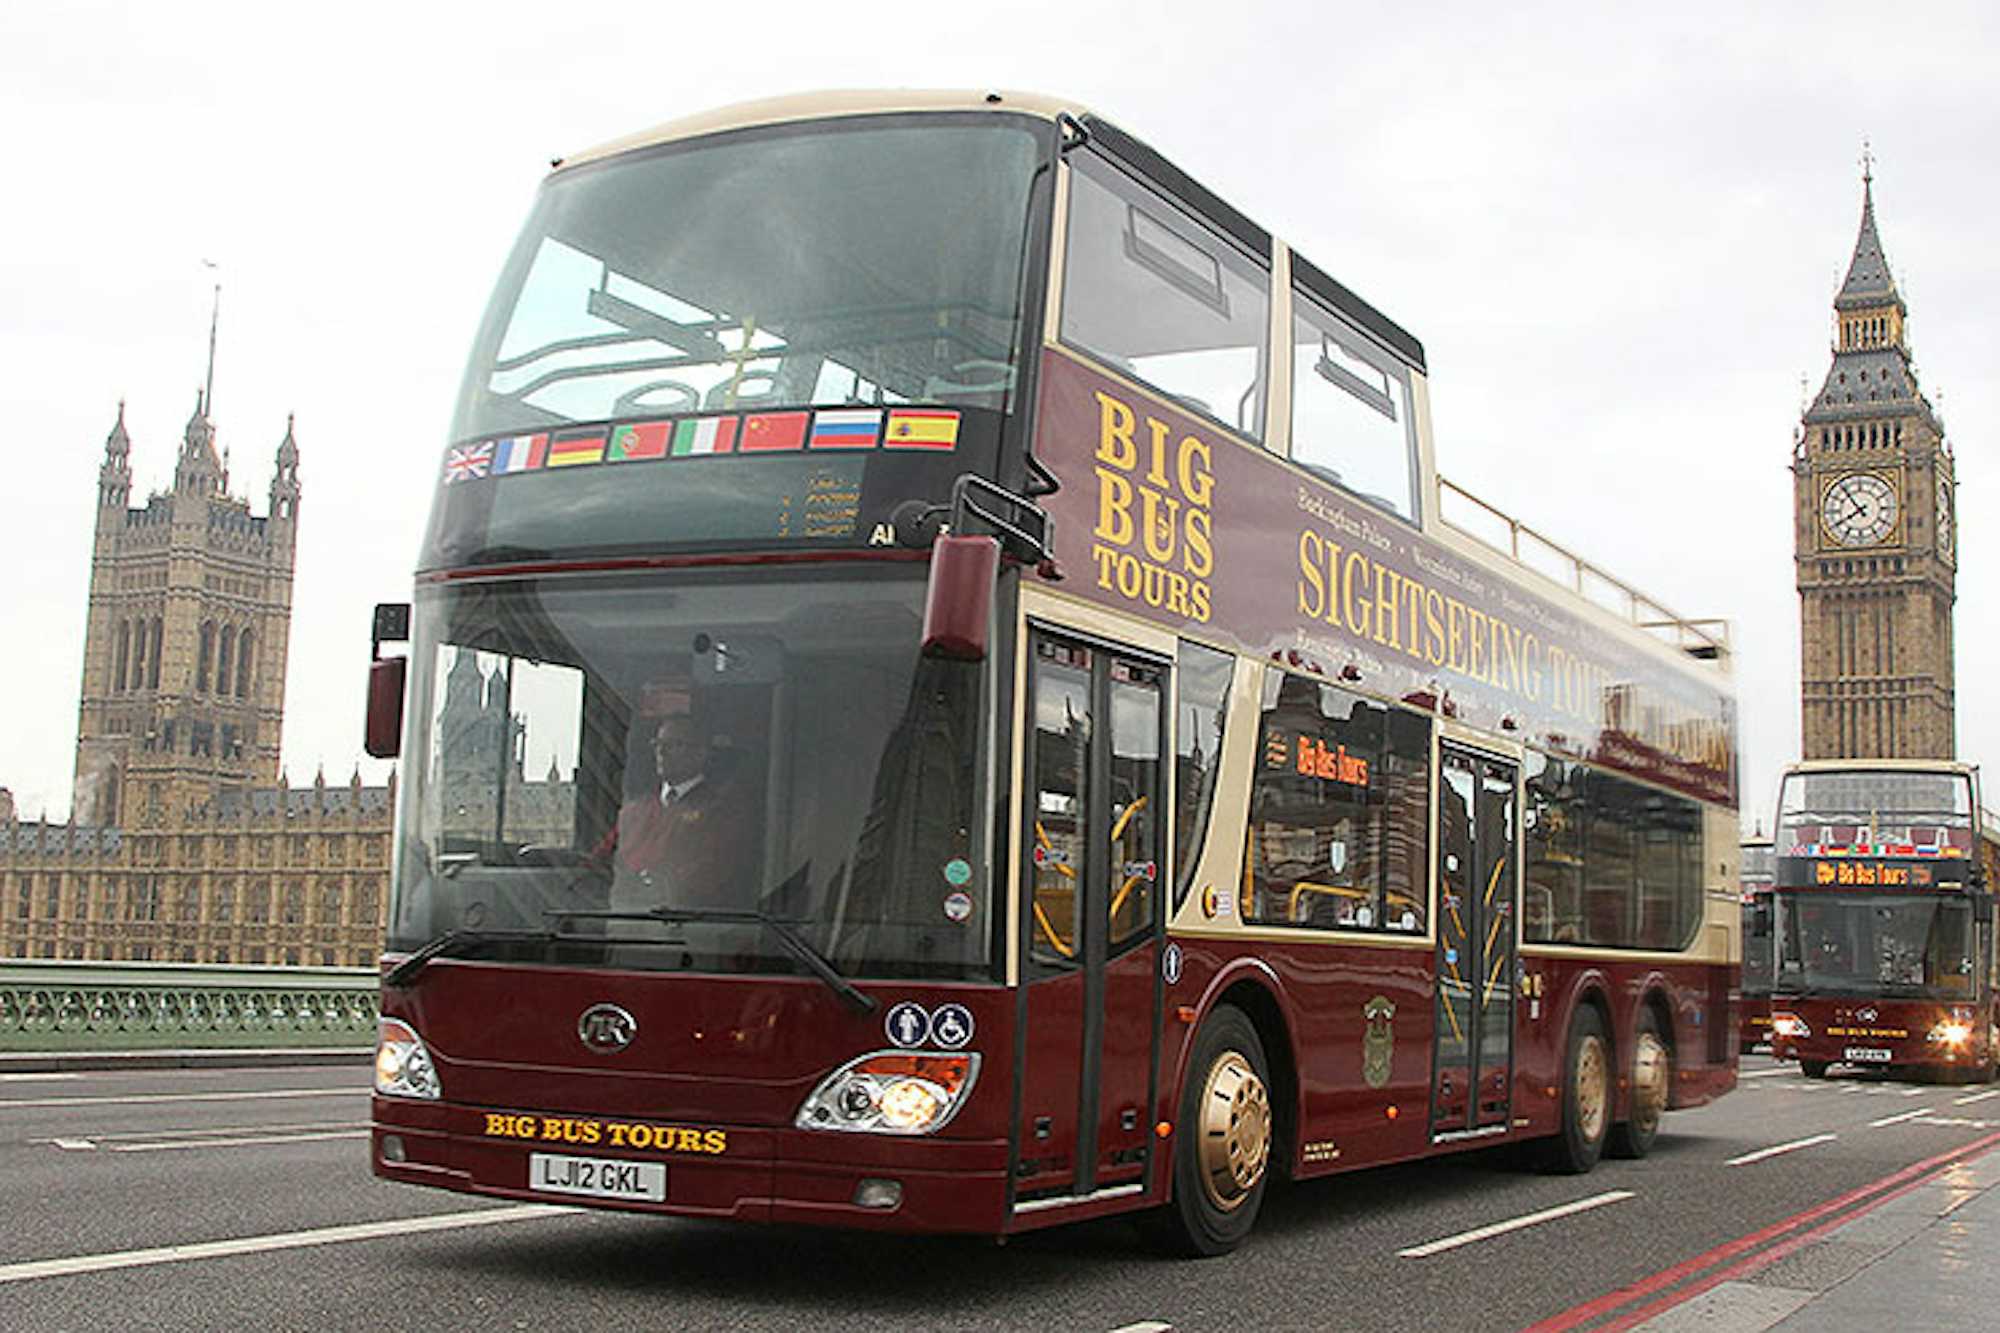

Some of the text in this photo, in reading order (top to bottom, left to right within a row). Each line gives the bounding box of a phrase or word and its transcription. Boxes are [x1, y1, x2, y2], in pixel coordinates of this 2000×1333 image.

[1094, 390, 1216, 509] BIG
[1094, 465, 1214, 579] BUS
[1093, 543, 1212, 624] TOURS
[1297, 529, 1542, 702] SIGHTSEEING
[484, 1113, 727, 1154] BIG BUS TOURS
[544, 1159, 648, 1193] LJ12 GKL
